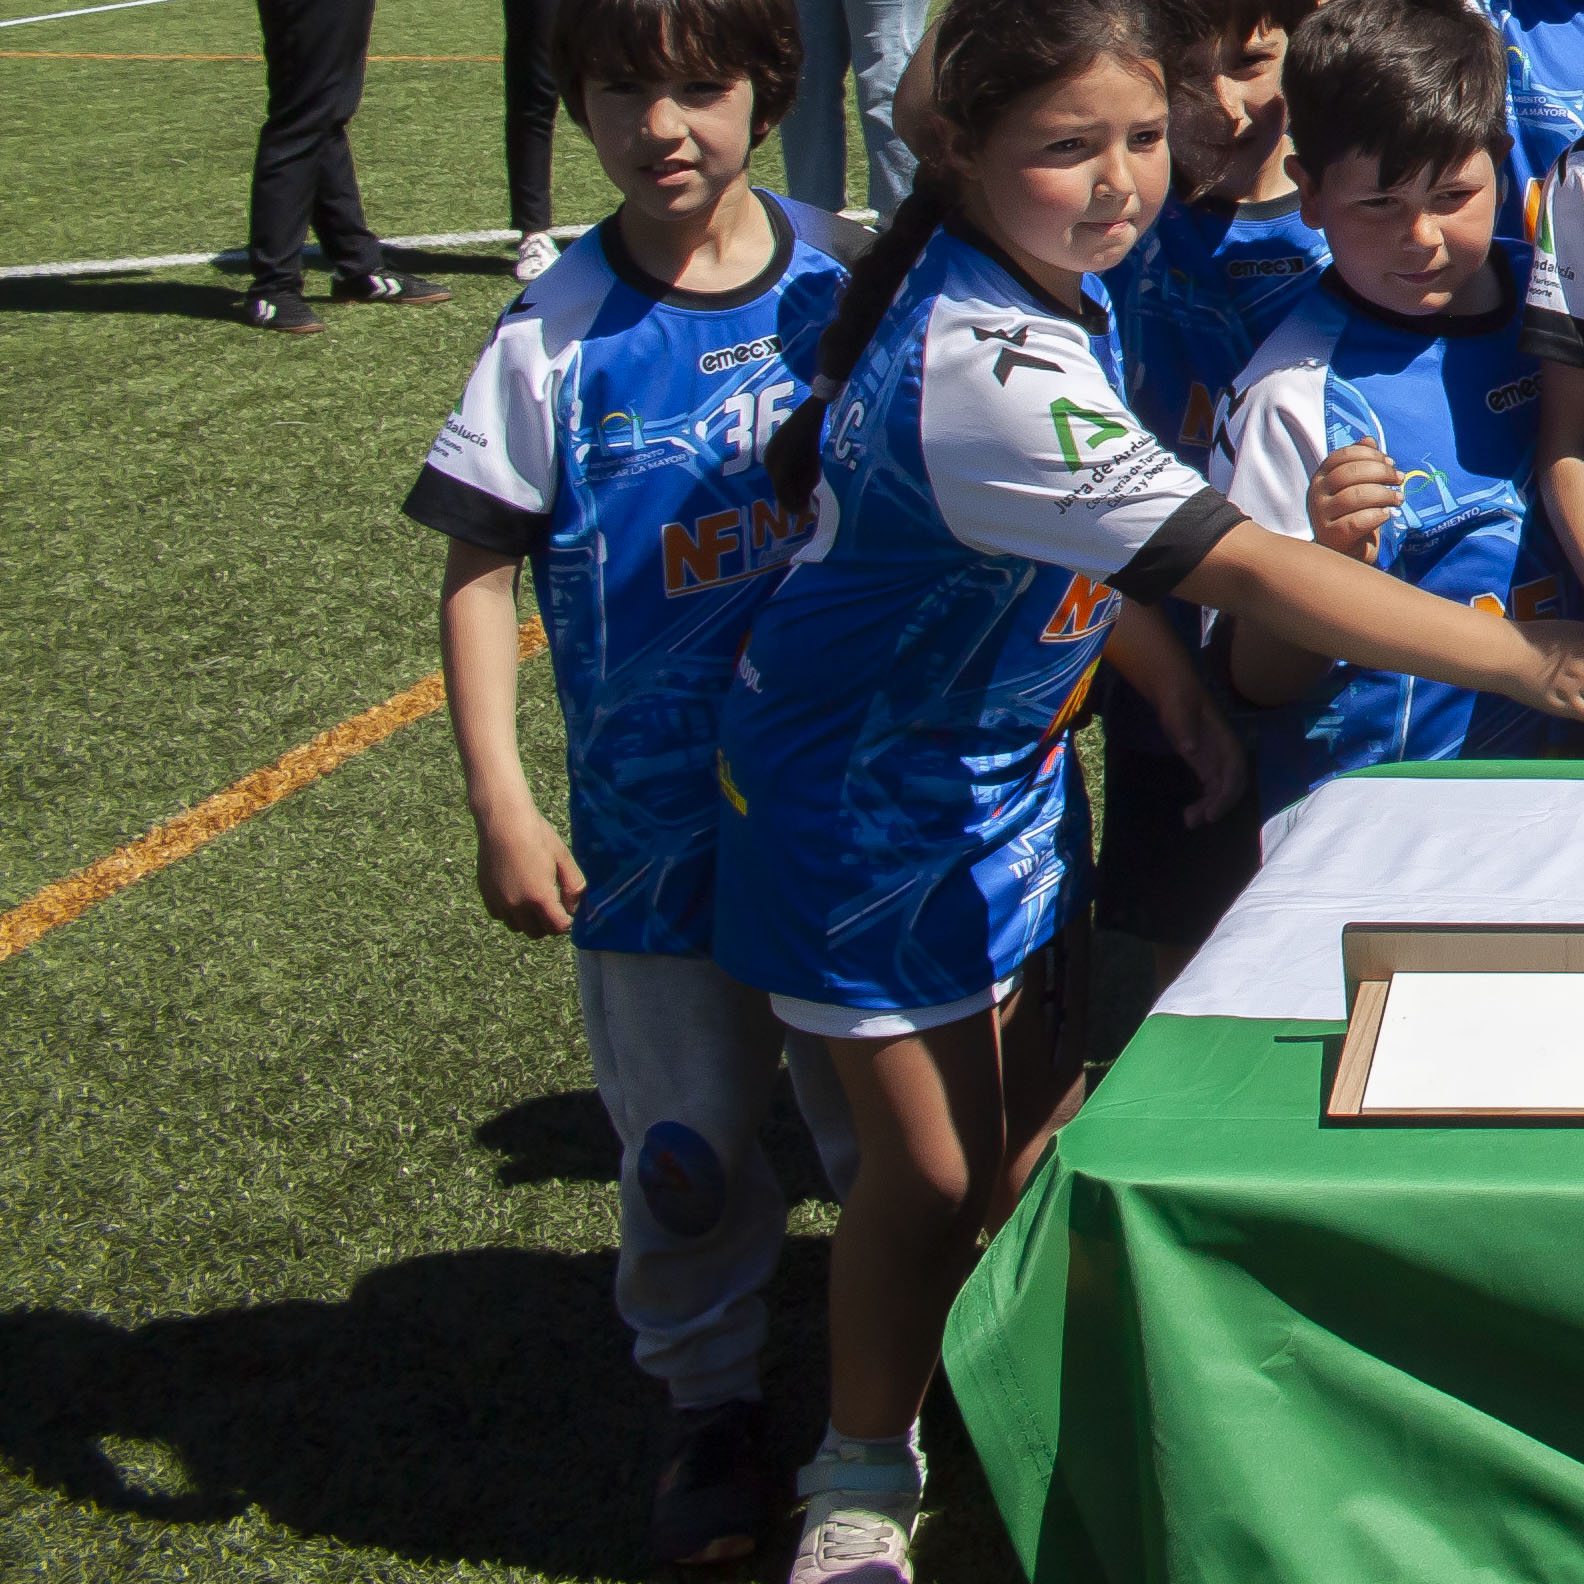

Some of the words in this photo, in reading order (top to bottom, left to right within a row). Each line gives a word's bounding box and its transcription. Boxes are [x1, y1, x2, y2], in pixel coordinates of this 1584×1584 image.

[701, 344, 766, 373] emec
[1053, 482, 1095, 515] Junta
[1091, 462, 1115, 484] de
[662, 506, 740, 593] NF
